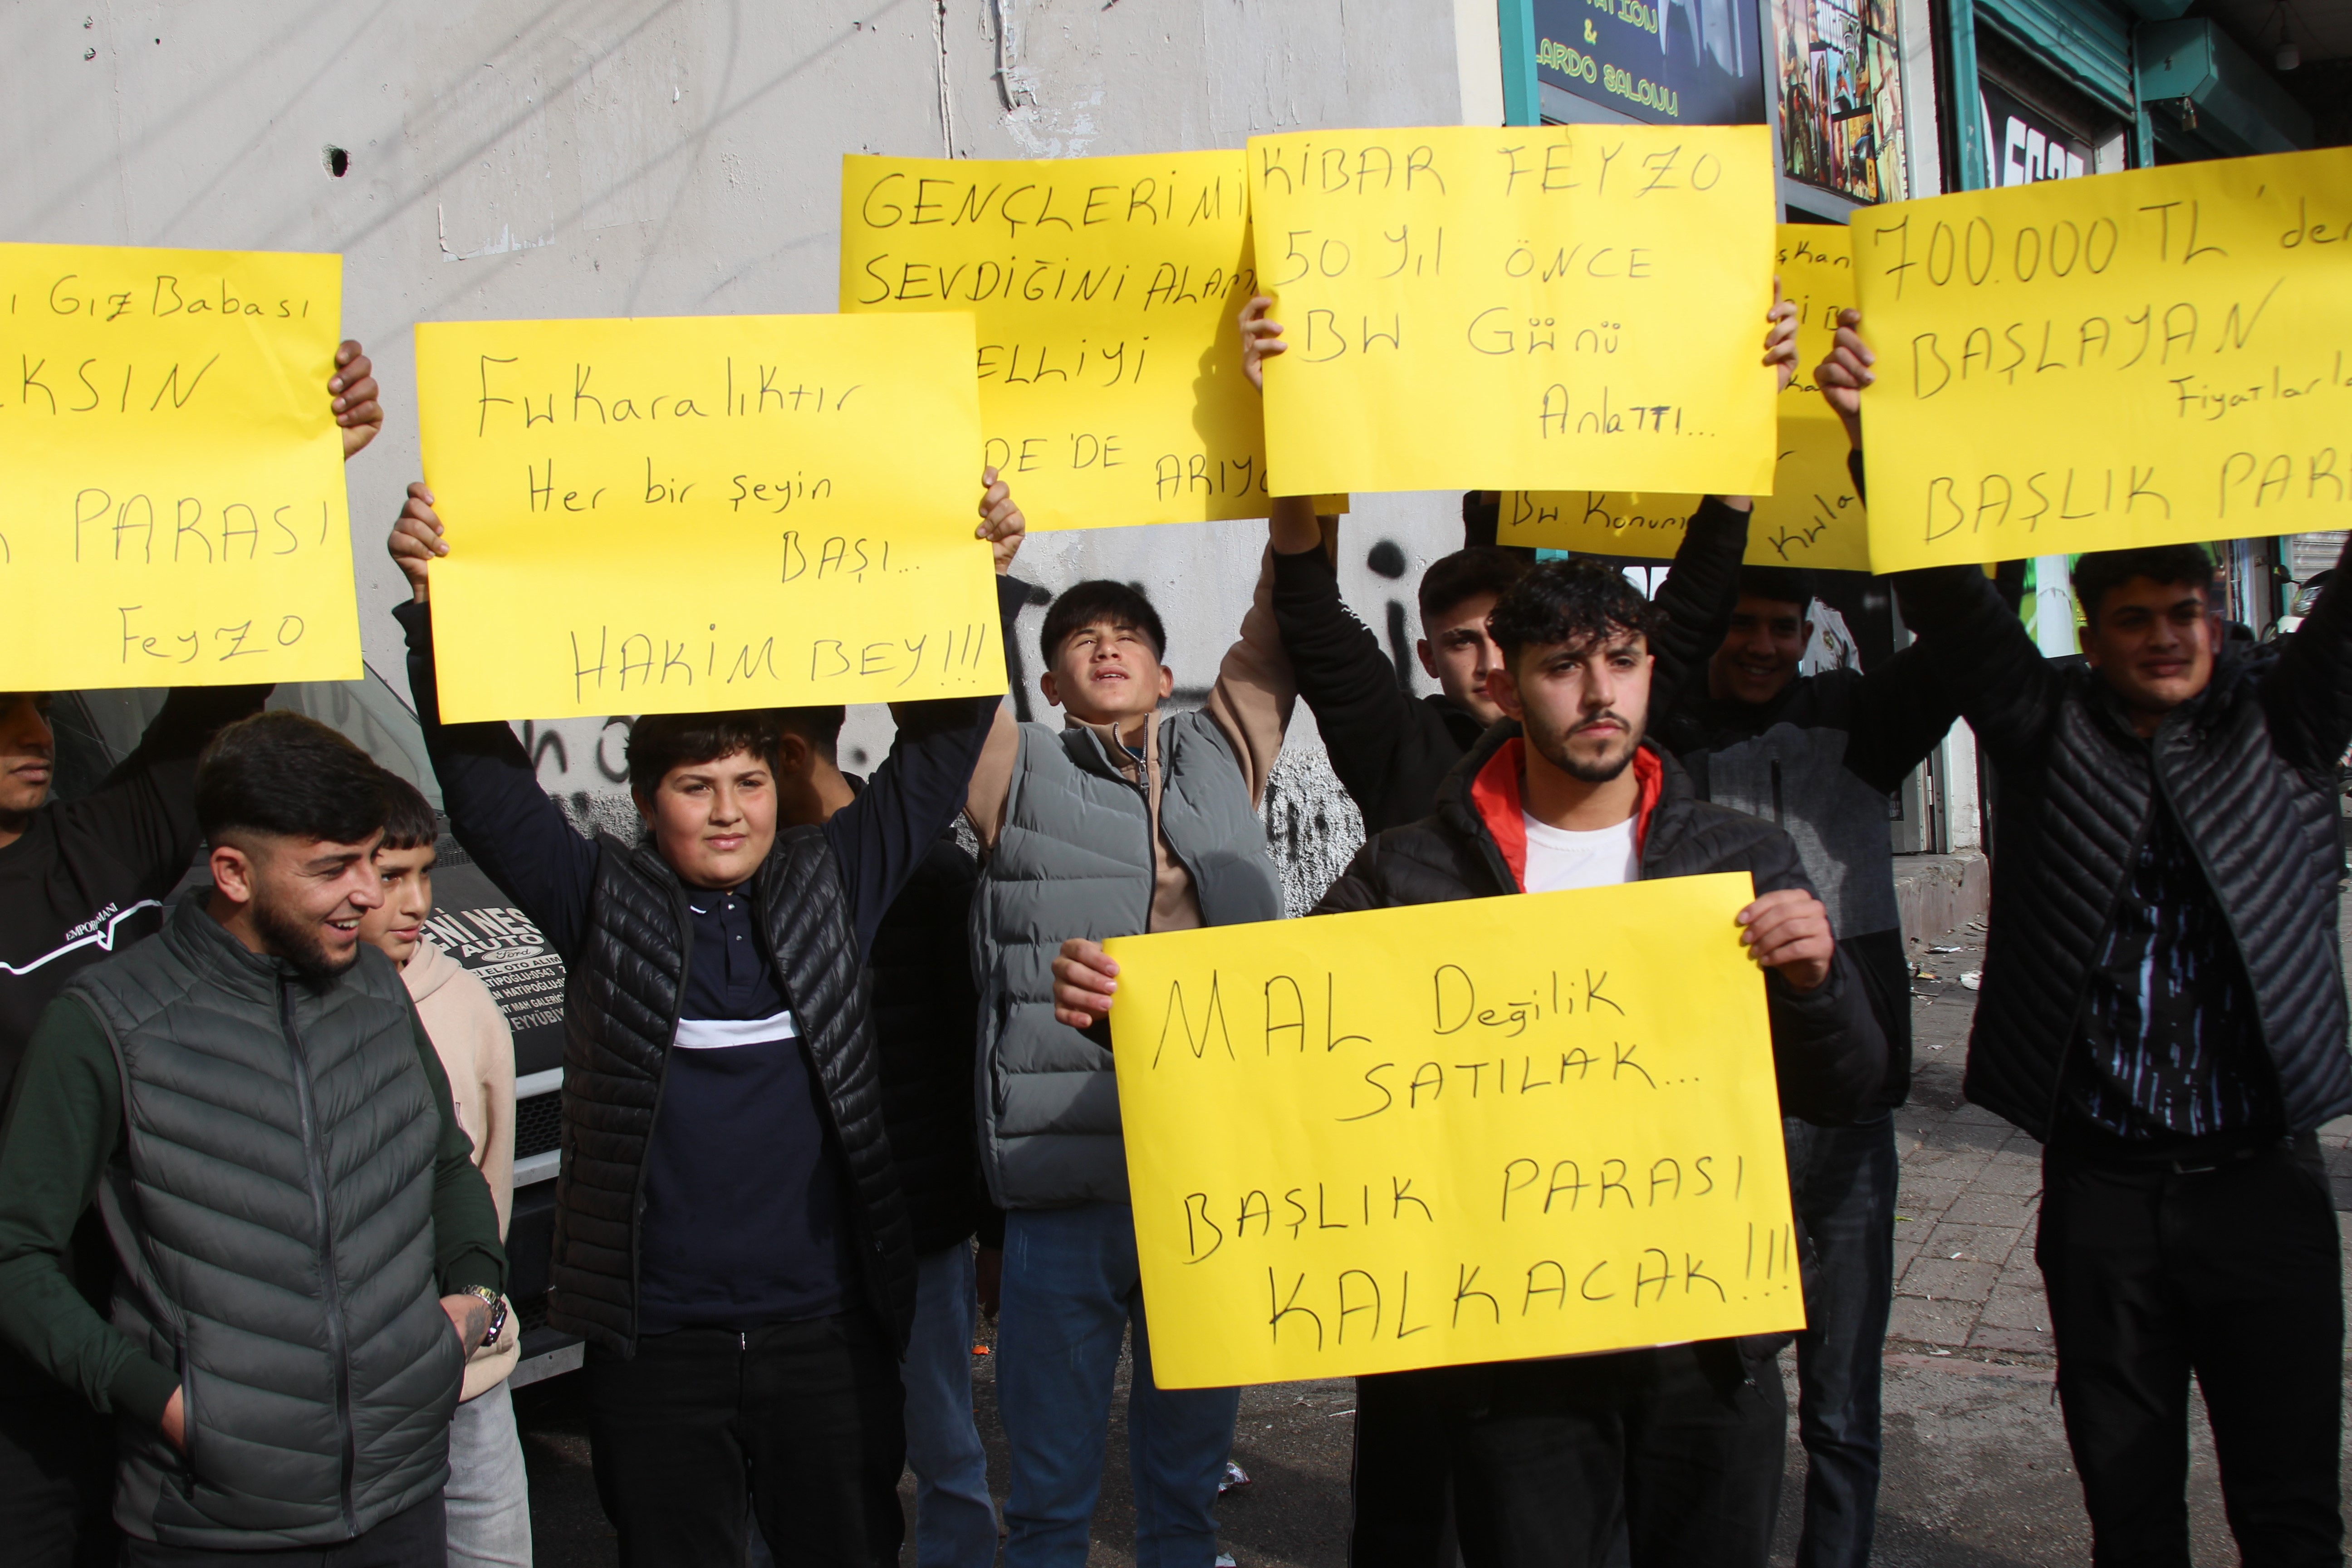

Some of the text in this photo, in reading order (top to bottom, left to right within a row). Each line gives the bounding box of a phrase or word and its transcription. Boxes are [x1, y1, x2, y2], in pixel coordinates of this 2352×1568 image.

[1536, 38, 1679, 118] ARDO SALONU
[1263, 142, 1720, 197] KİBAR FEYZO
[863, 169, 1242, 238] GENÇLERİMİ
[859, 254, 1257, 311] SEVDİĞİNİ ALAM
[1273, 230, 1350, 287] 50
[1506, 240, 1649, 283] ÖNCE
[1875, 215, 2117, 299] 700.000
[978, 336, 1149, 387] ELLİYİ
[1912, 276, 2285, 400] BAŞLAYAN
[0, 353, 220, 415] KSIN
[529, 456, 831, 514] Her bir şeyin
[1924, 447, 2352, 544] BAŞLIK PAR
[75, 489, 327, 564] PARASI
[571, 623, 778, 704] HAKİM
[461, 907, 542, 937] NES
[461, 934, 545, 958] AUTO
[485, 967, 556, 988] ATİPOĞLU:0543
[496, 947, 531, 959] Ford
[504, 961, 529, 971] OTO
[533, 956, 562, 966] ALIM
[510, 1000, 532, 1012] MAH
[530, 992, 564, 1008] GALERİCİ
[1152, 969, 1372, 1070] MAL
[1183, 1156, 1743, 1264] BAŞLIK PARASI
[1269, 1222, 1789, 1352] KALKACAK!!!
